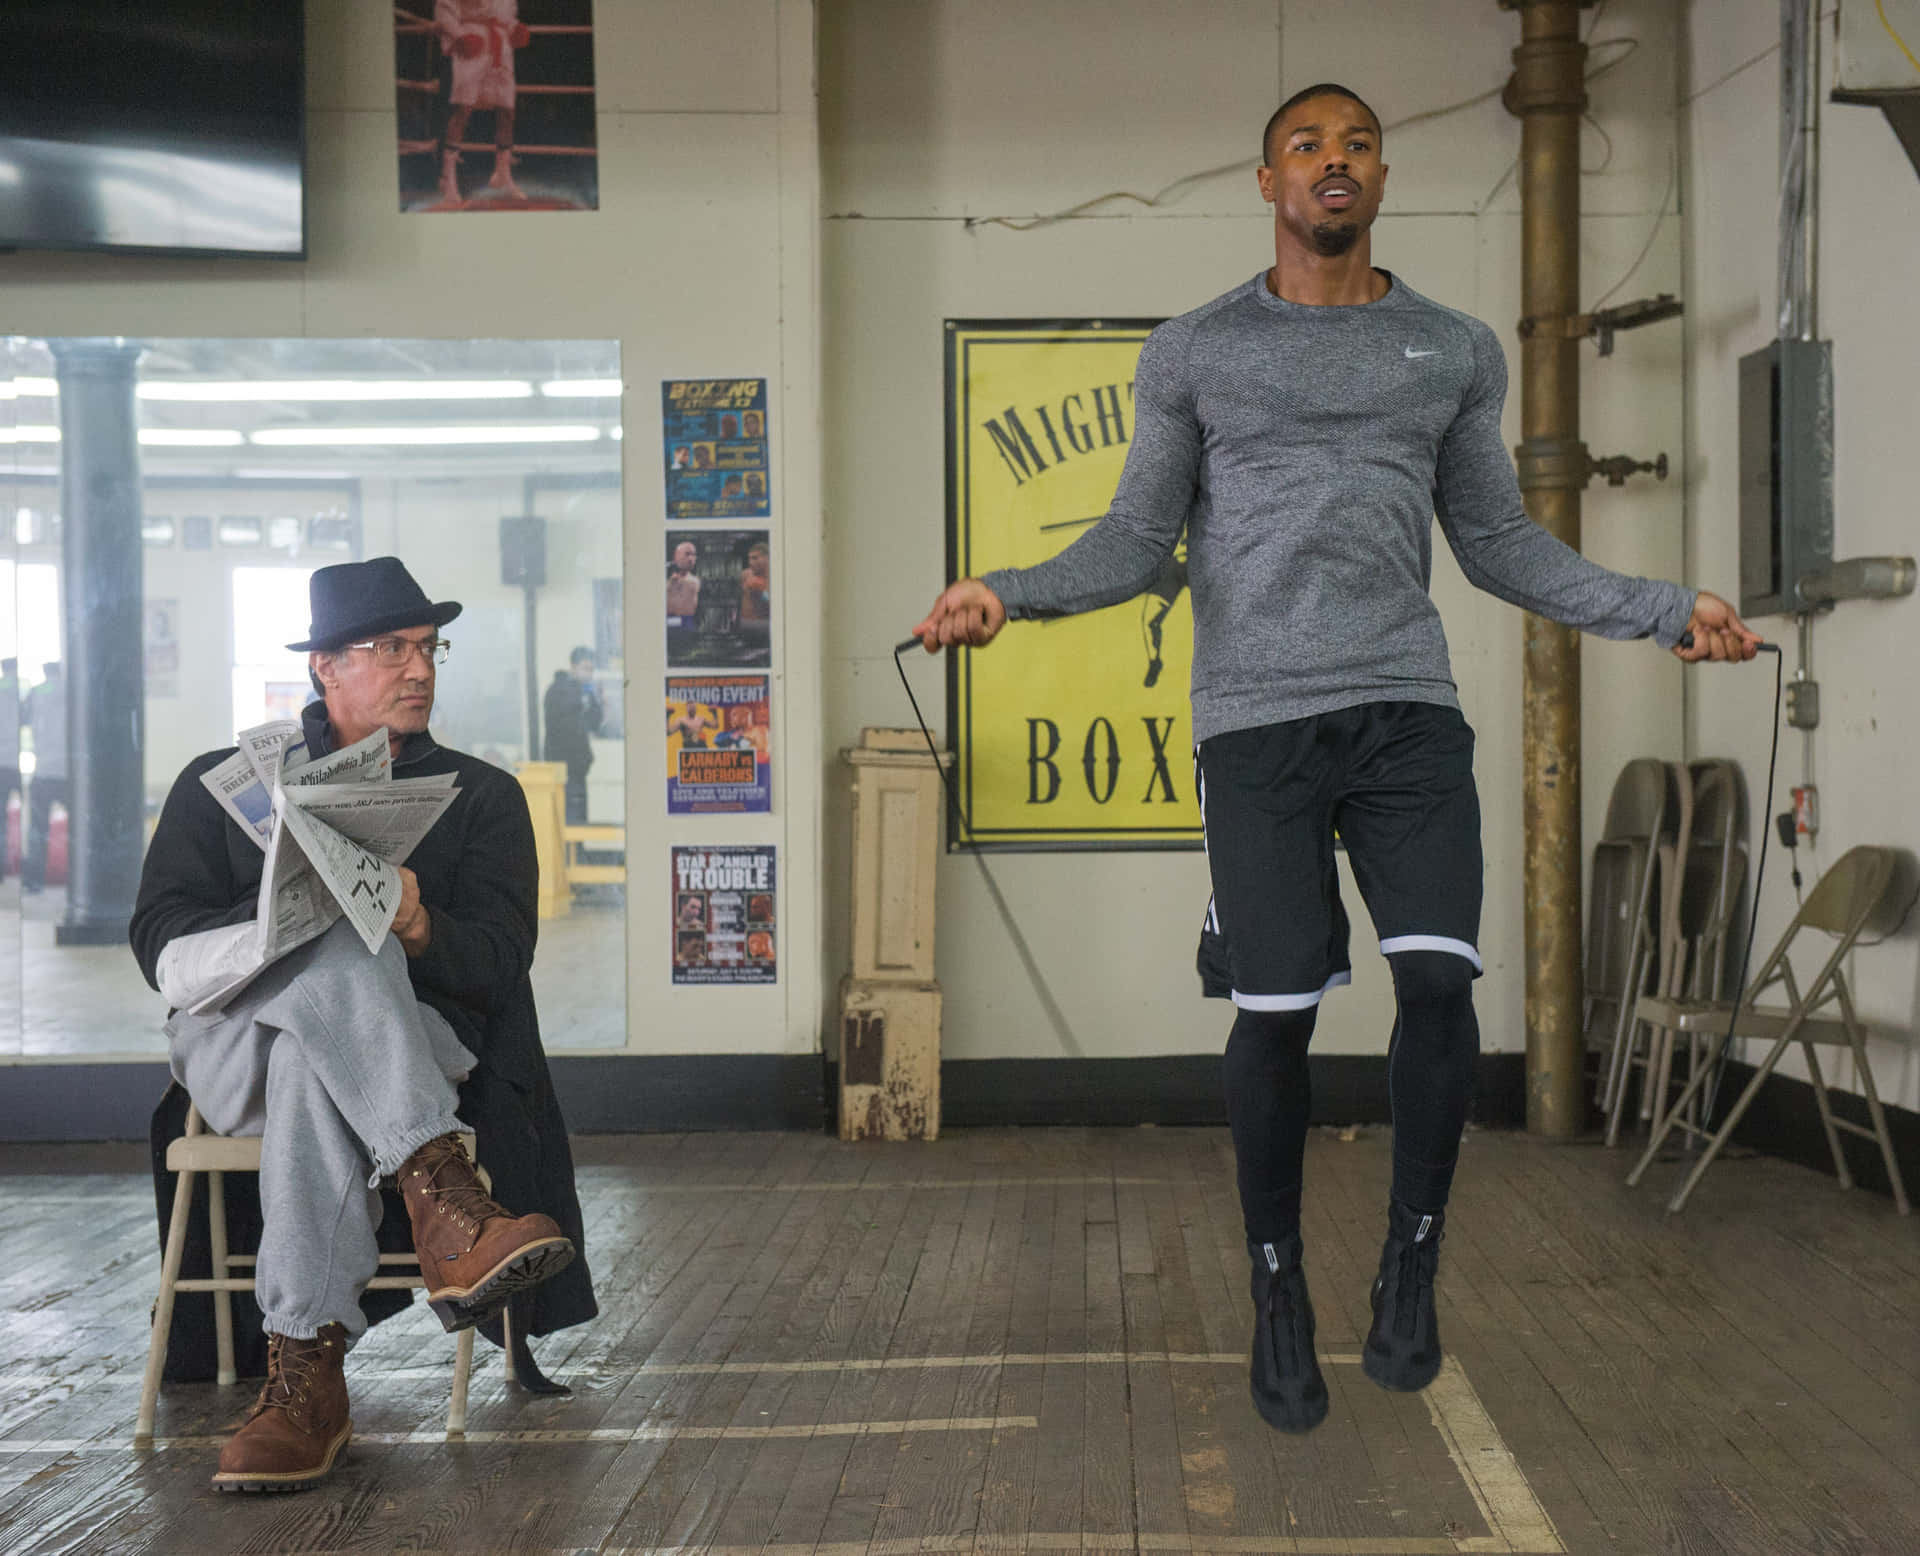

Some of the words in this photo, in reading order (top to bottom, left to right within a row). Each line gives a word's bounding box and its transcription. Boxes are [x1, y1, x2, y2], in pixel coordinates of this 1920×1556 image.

[669, 380, 760, 400] BOXING
[982, 381, 1135, 488] MIGH
[722, 685, 765, 703] EVENT
[677, 868, 769, 890] TROUBLE
